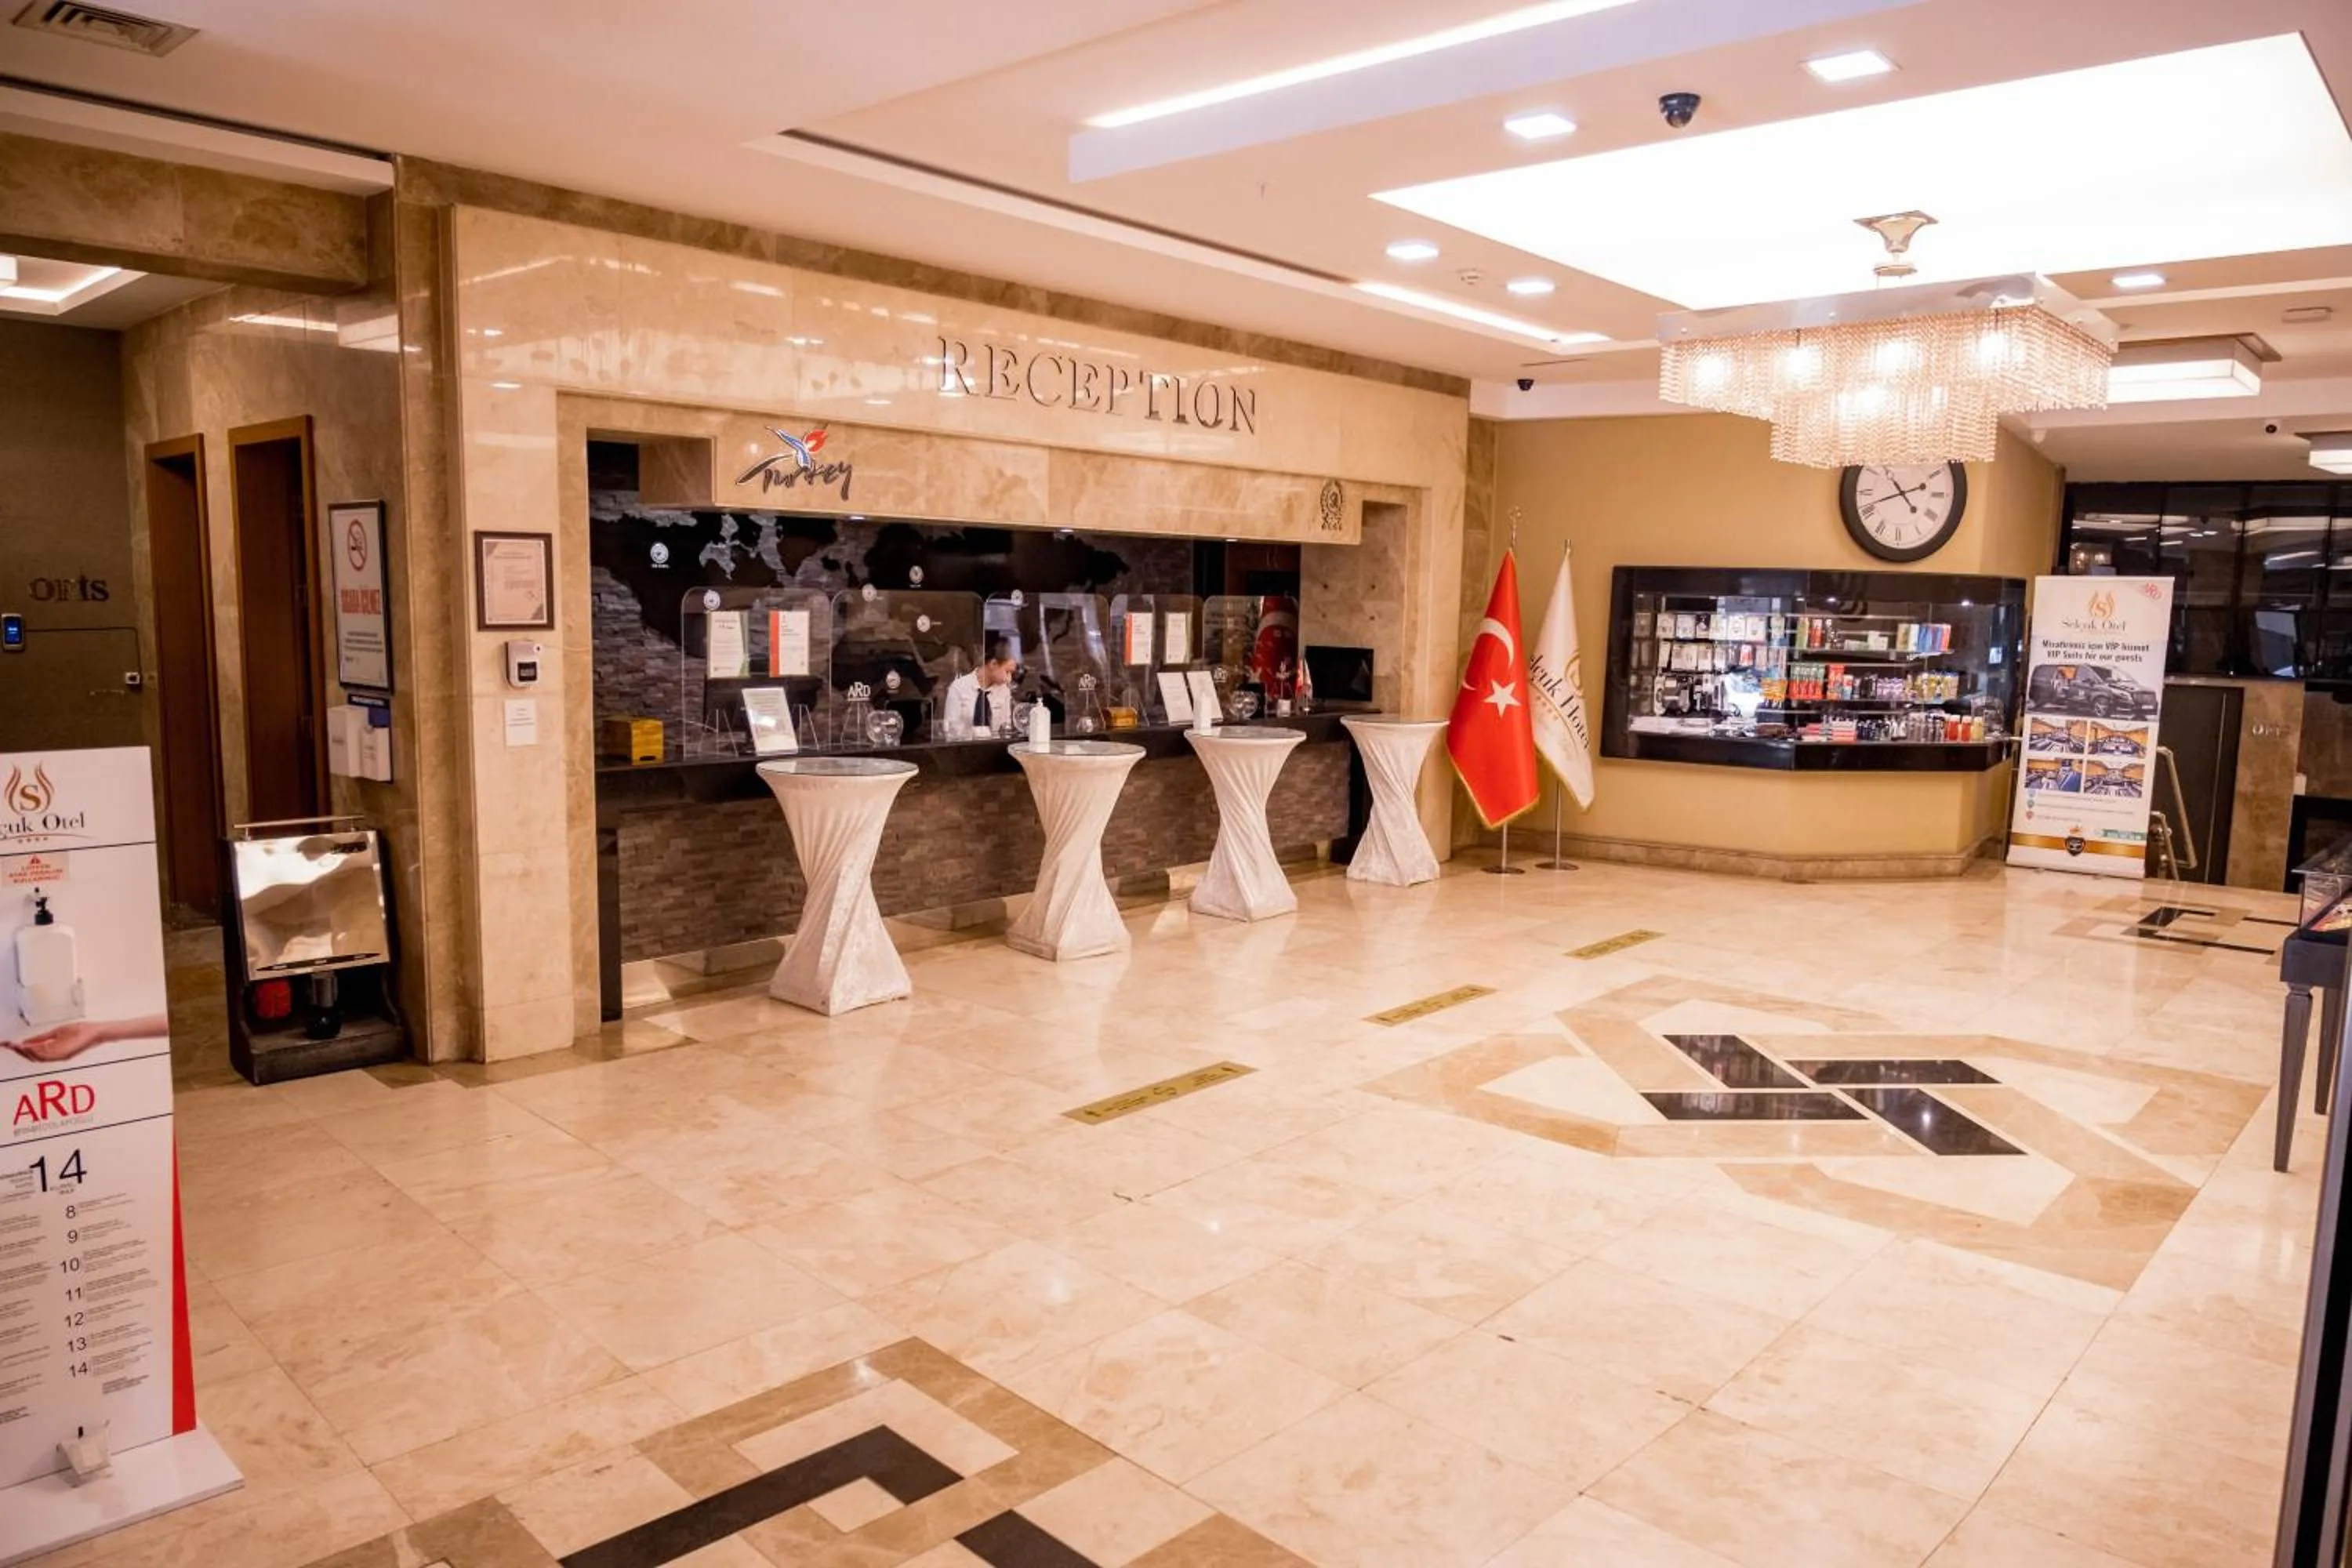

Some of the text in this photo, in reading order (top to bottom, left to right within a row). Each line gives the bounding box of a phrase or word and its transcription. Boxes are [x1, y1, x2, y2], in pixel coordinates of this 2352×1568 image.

[938, 336, 1255, 434] RECEPTION
[848, 681, 871, 697] ARD
[20, 785, 41, 811] S
[42, 811, 85, 830] Otel
[13, 1080, 95, 1126] ARD
[29, 1148, 87, 1192] 14
[65, 1205, 76, 1219] 8
[67, 1229, 78, 1244] 9
[60, 1258, 80, 1273] 10
[65, 1287, 82, 1301] 11
[64, 1312, 85, 1327] 12
[67, 1337, 87, 1352] 13
[69, 1361, 88, 1378] 14
